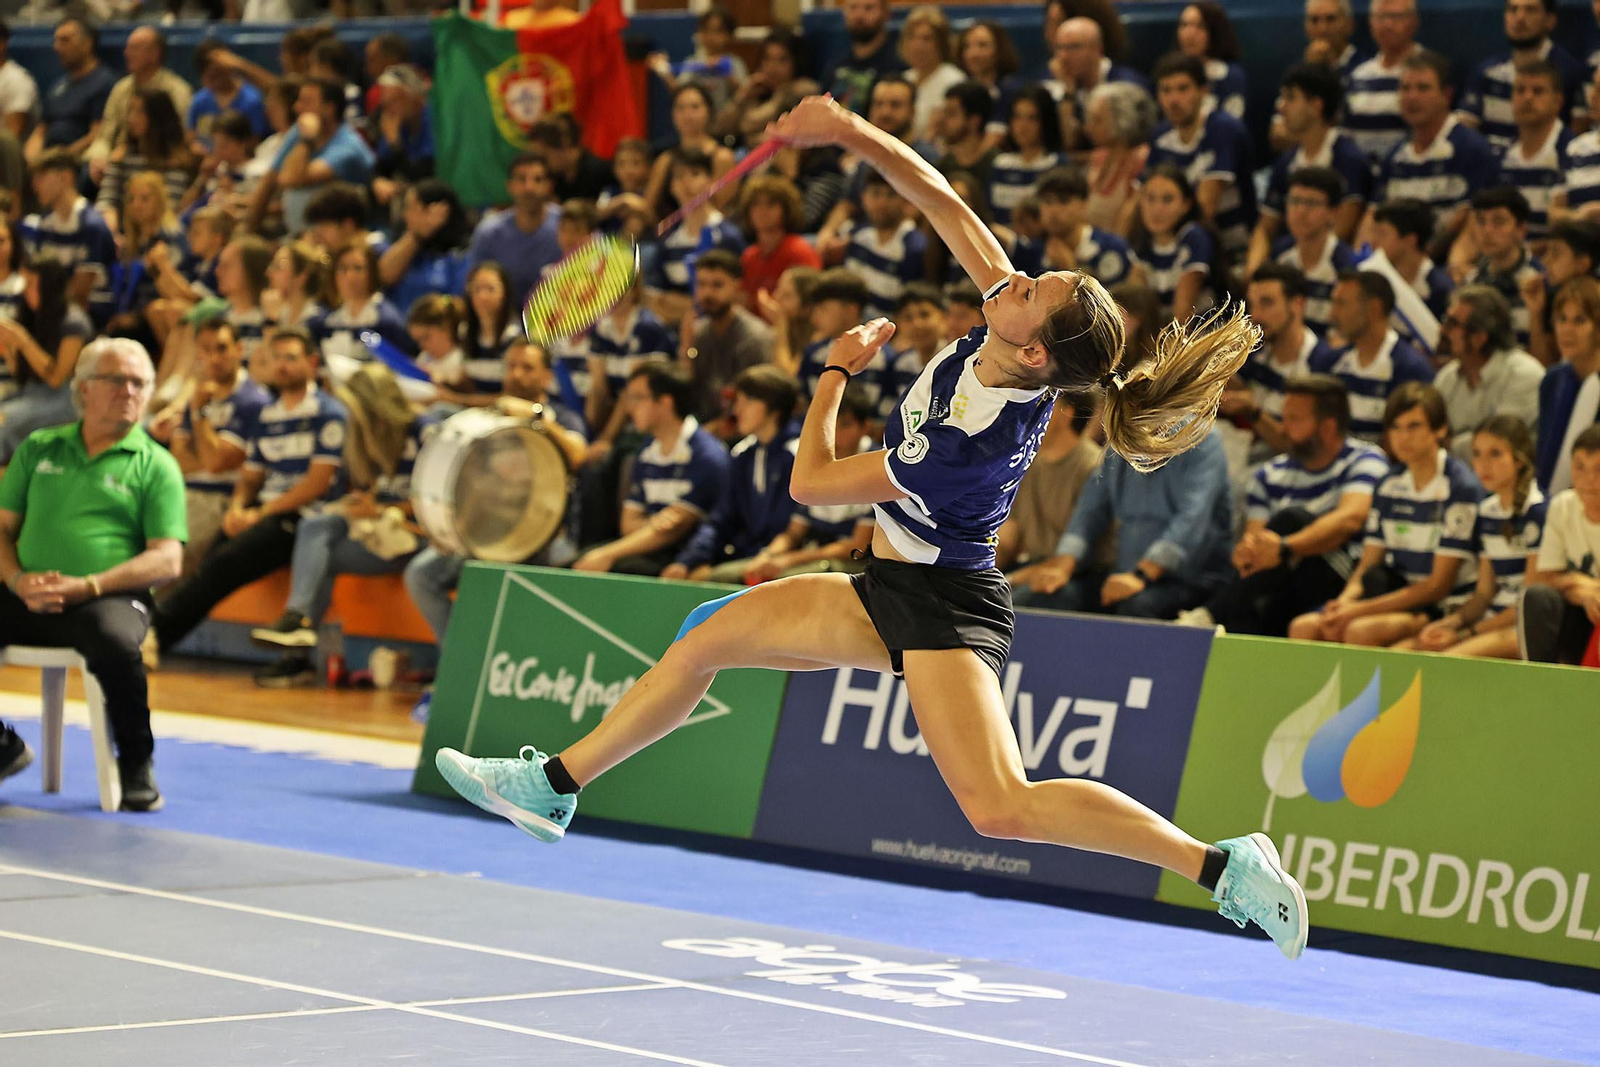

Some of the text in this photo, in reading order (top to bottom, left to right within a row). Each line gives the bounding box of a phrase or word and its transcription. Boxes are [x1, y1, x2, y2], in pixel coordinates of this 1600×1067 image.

[488, 652, 516, 697] El
[514, 657, 577, 705] Corte
[820, 661, 1119, 778] Hulva
[1281, 834, 1600, 943] IBERDROL
